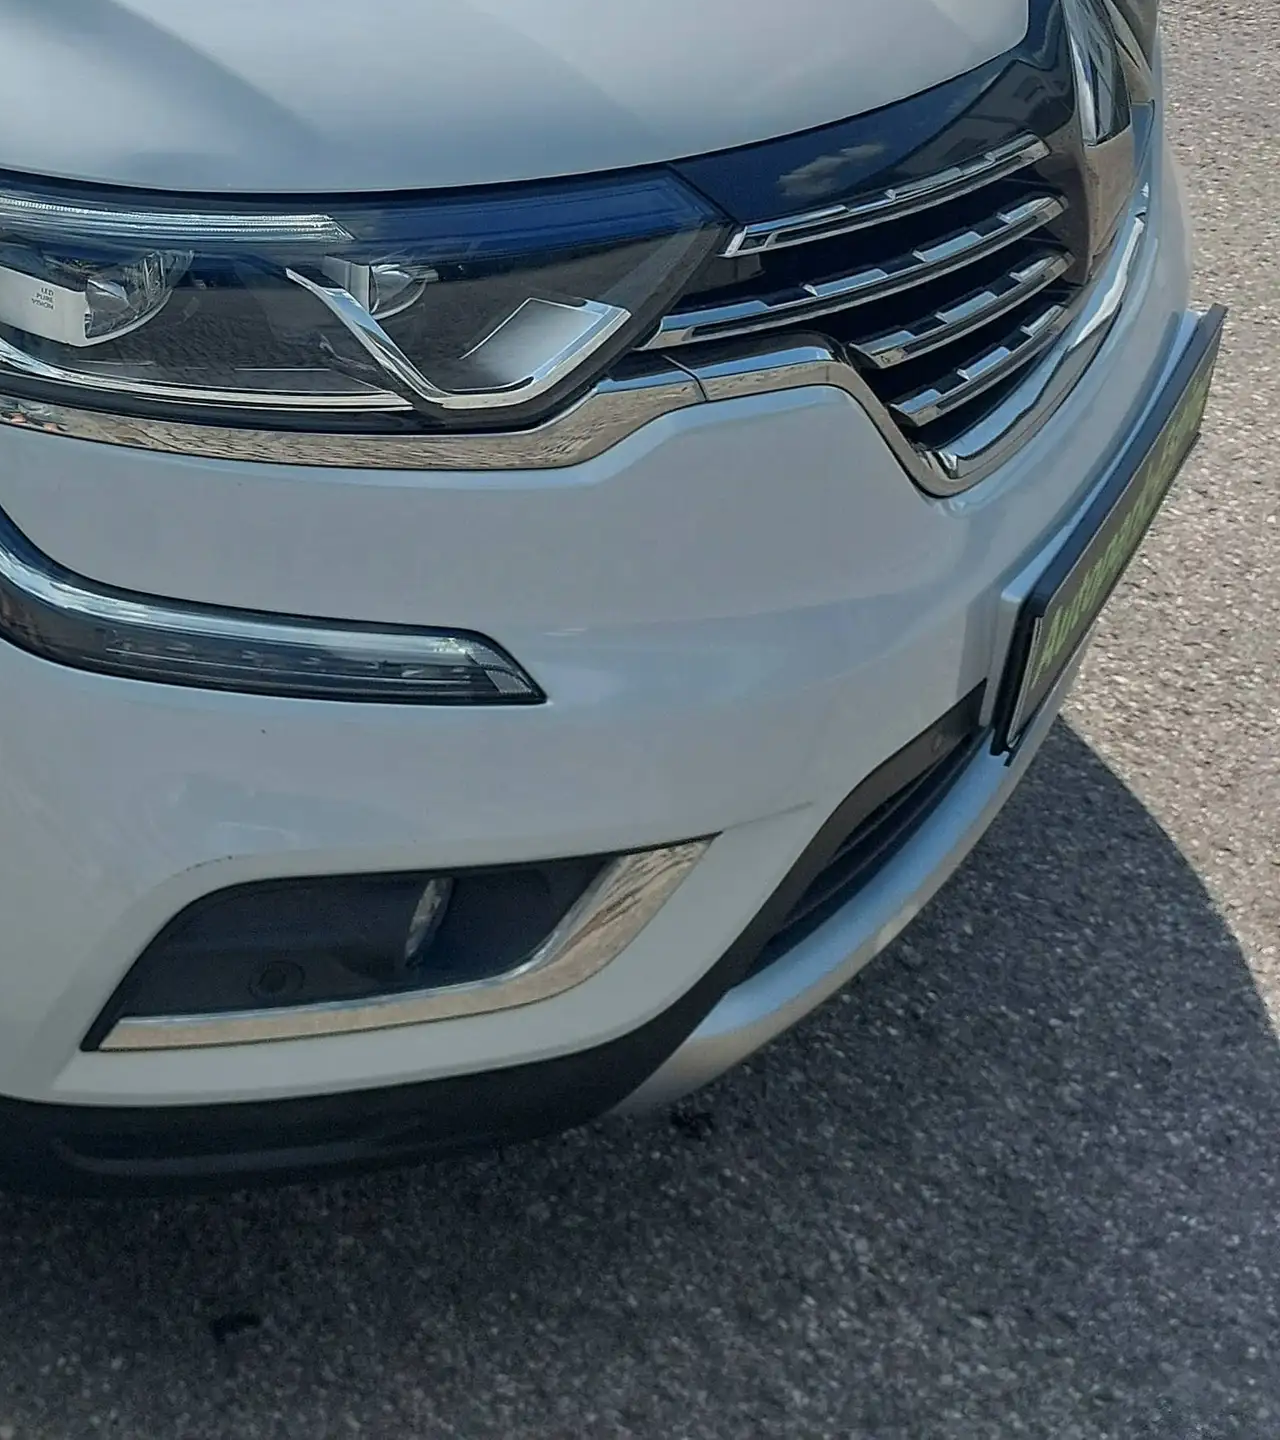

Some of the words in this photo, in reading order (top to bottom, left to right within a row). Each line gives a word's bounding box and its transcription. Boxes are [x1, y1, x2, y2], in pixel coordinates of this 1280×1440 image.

[36, 292, 54, 303] PURE
[41, 287, 54, 297] LED
[31, 297, 54, 310] VISION
